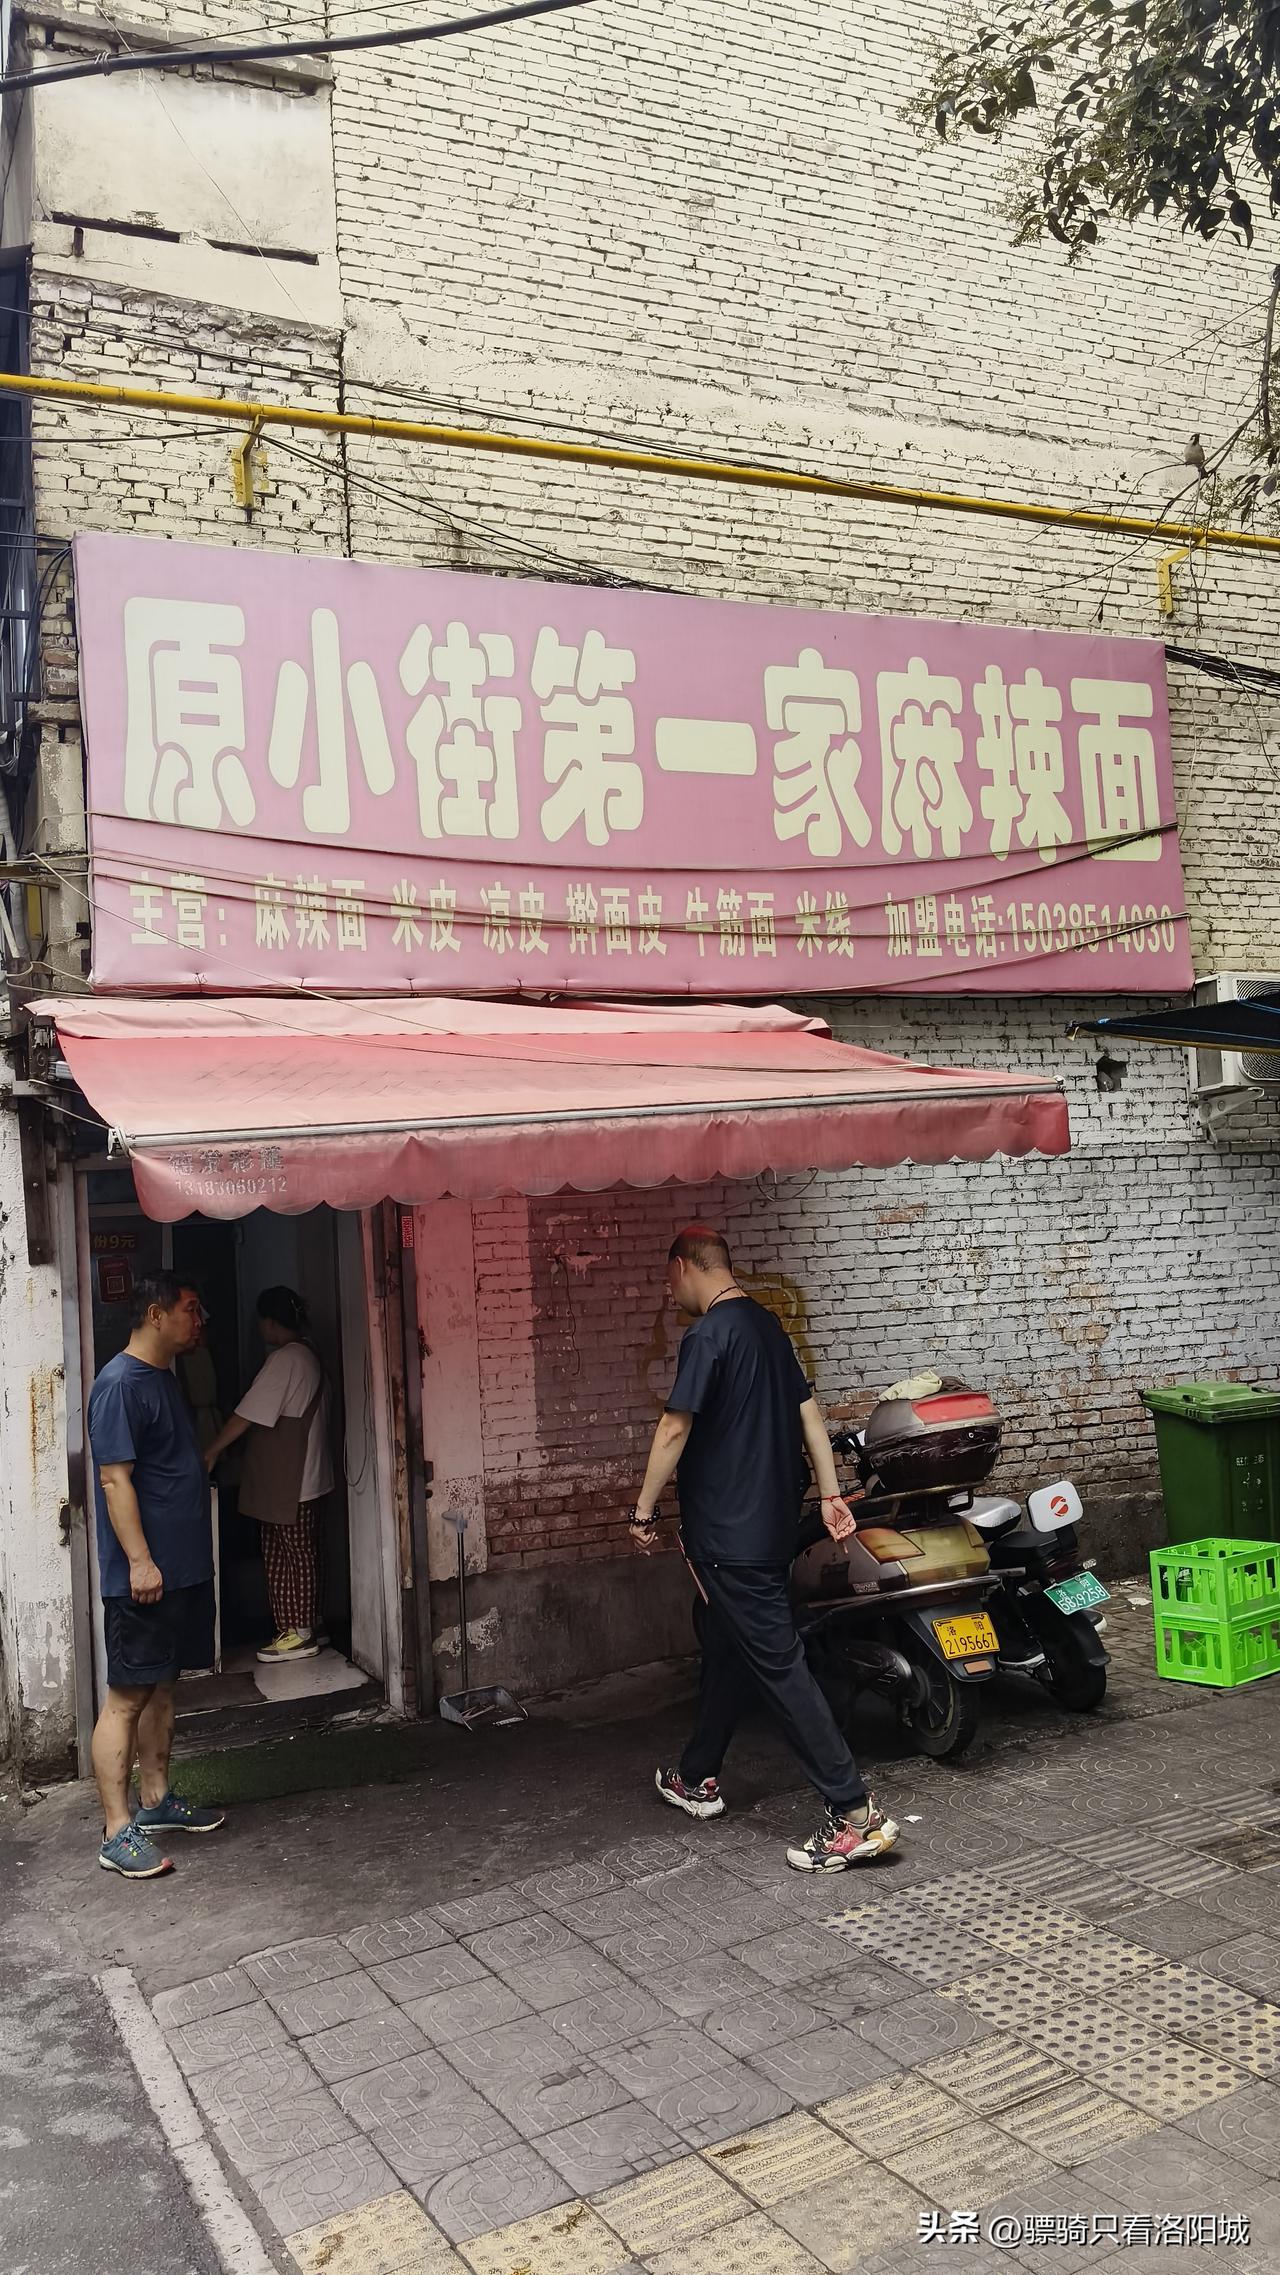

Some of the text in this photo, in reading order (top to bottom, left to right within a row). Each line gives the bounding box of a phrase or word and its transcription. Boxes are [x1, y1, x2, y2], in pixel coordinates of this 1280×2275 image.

[123, 596, 1162, 863] 原小街第一家麻辣面
[254, 872, 367, 952] 麻辣面
[390, 878, 462, 953] 米皮
[481, 880, 549, 955] 凉皮
[566, 883, 668, 956] 擀面皮
[686, 886, 778, 958] 牛筋面
[795, 890, 855, 958] 米线
[945, 1631, 995, 1655] 2195667
